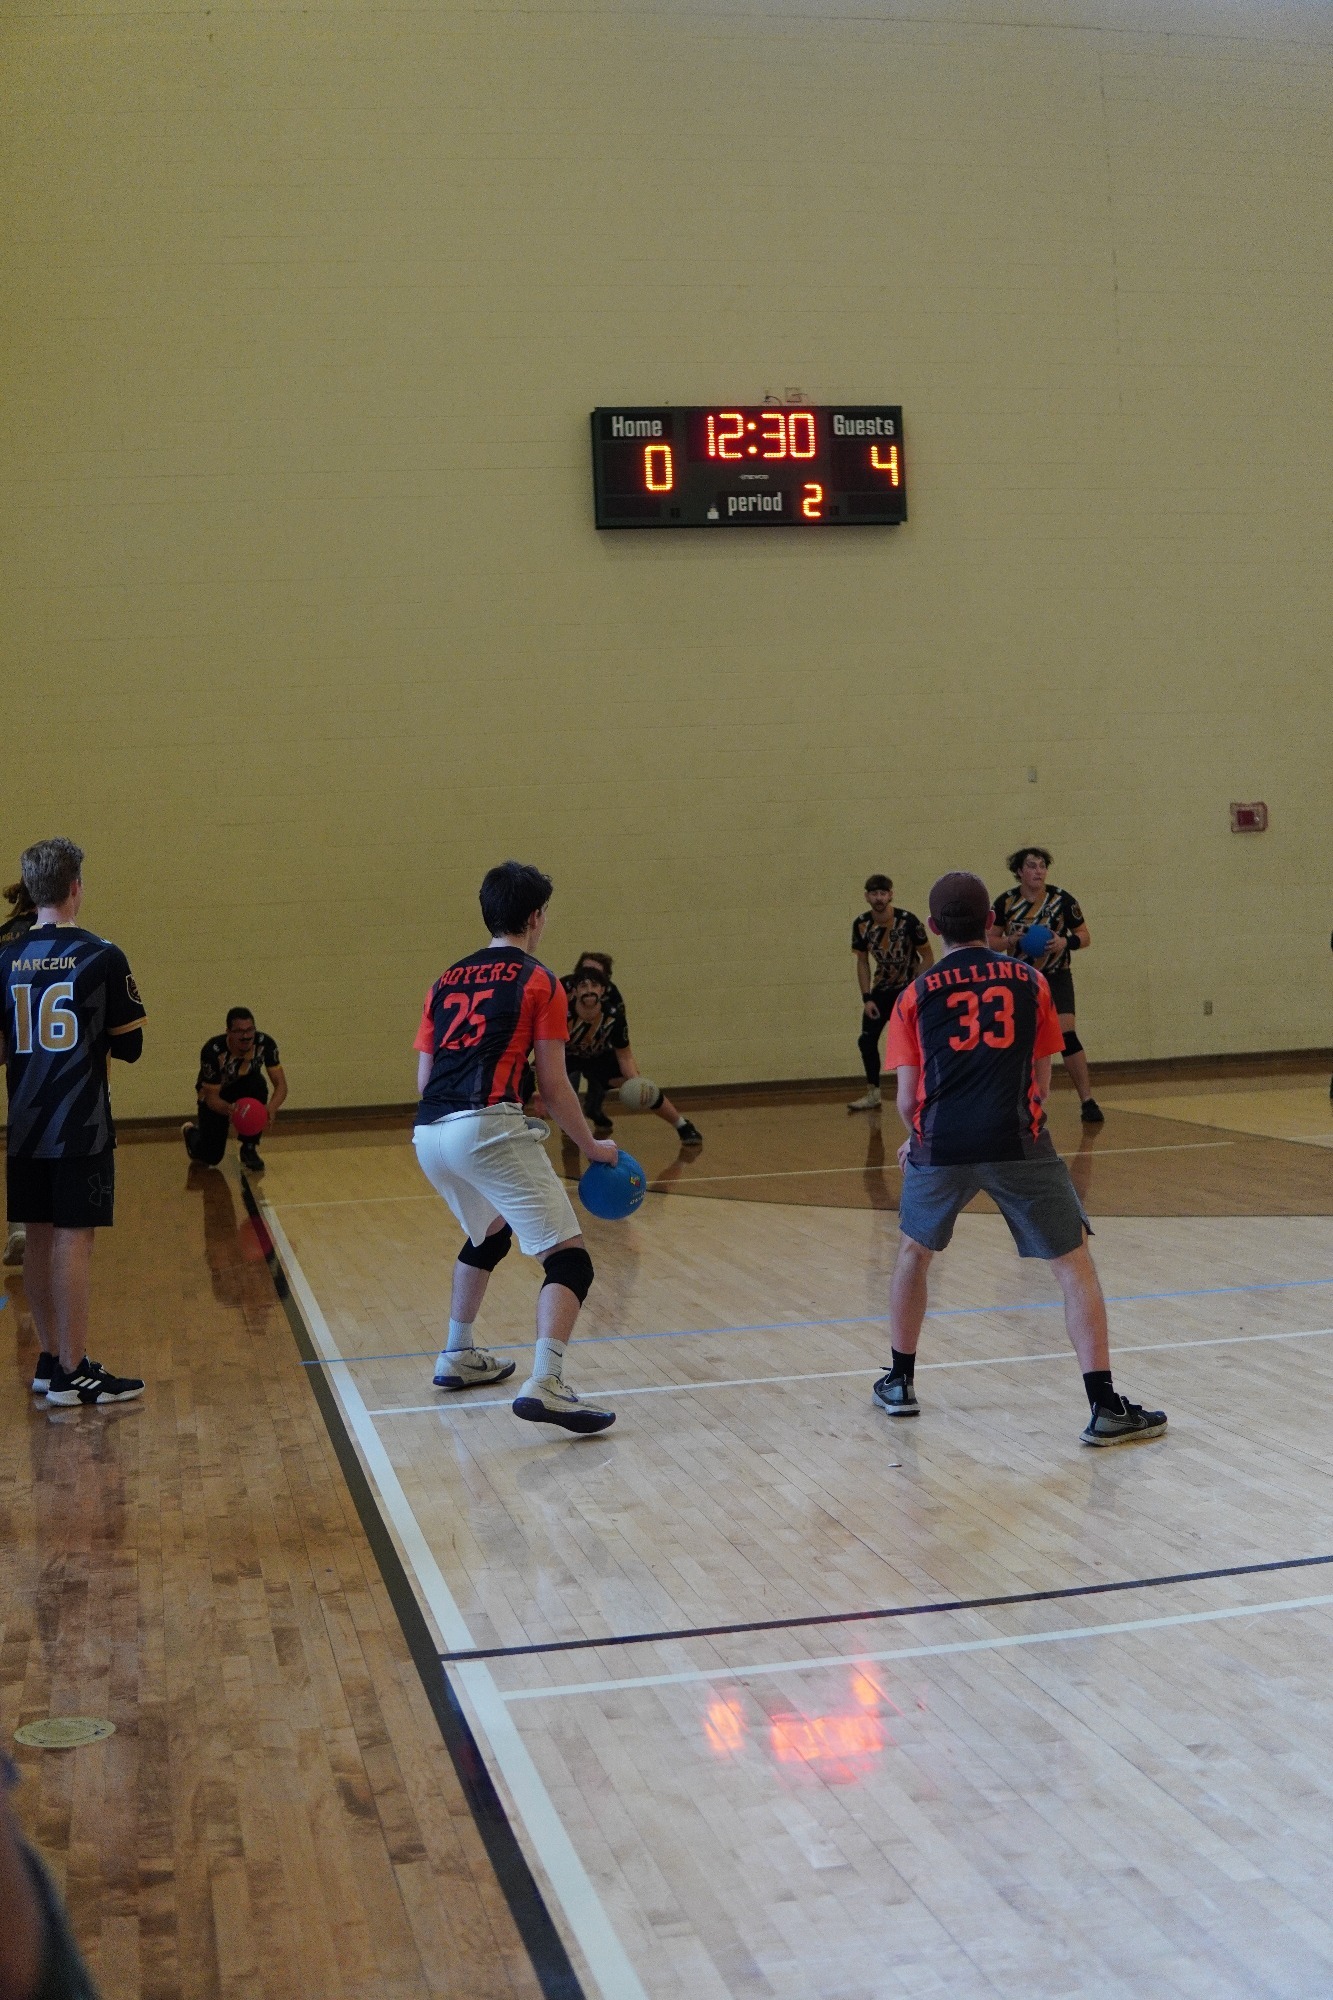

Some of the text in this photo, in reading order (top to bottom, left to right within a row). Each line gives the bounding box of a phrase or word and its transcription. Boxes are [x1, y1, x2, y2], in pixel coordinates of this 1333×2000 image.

[612, 416, 662, 437] Home
[707, 413, 816, 458] 12:30
[833, 414, 895, 436] Guests
[644, 445, 673, 491] 0
[870, 445, 899, 486] 4
[728, 484, 823, 517] period 2
[12, 956, 77, 972] MARCZUK
[924, 961, 1029, 992] HILLING
[10, 981, 79, 1053] 16
[439, 988, 494, 1050] 25
[946, 985, 1015, 1051] 33
